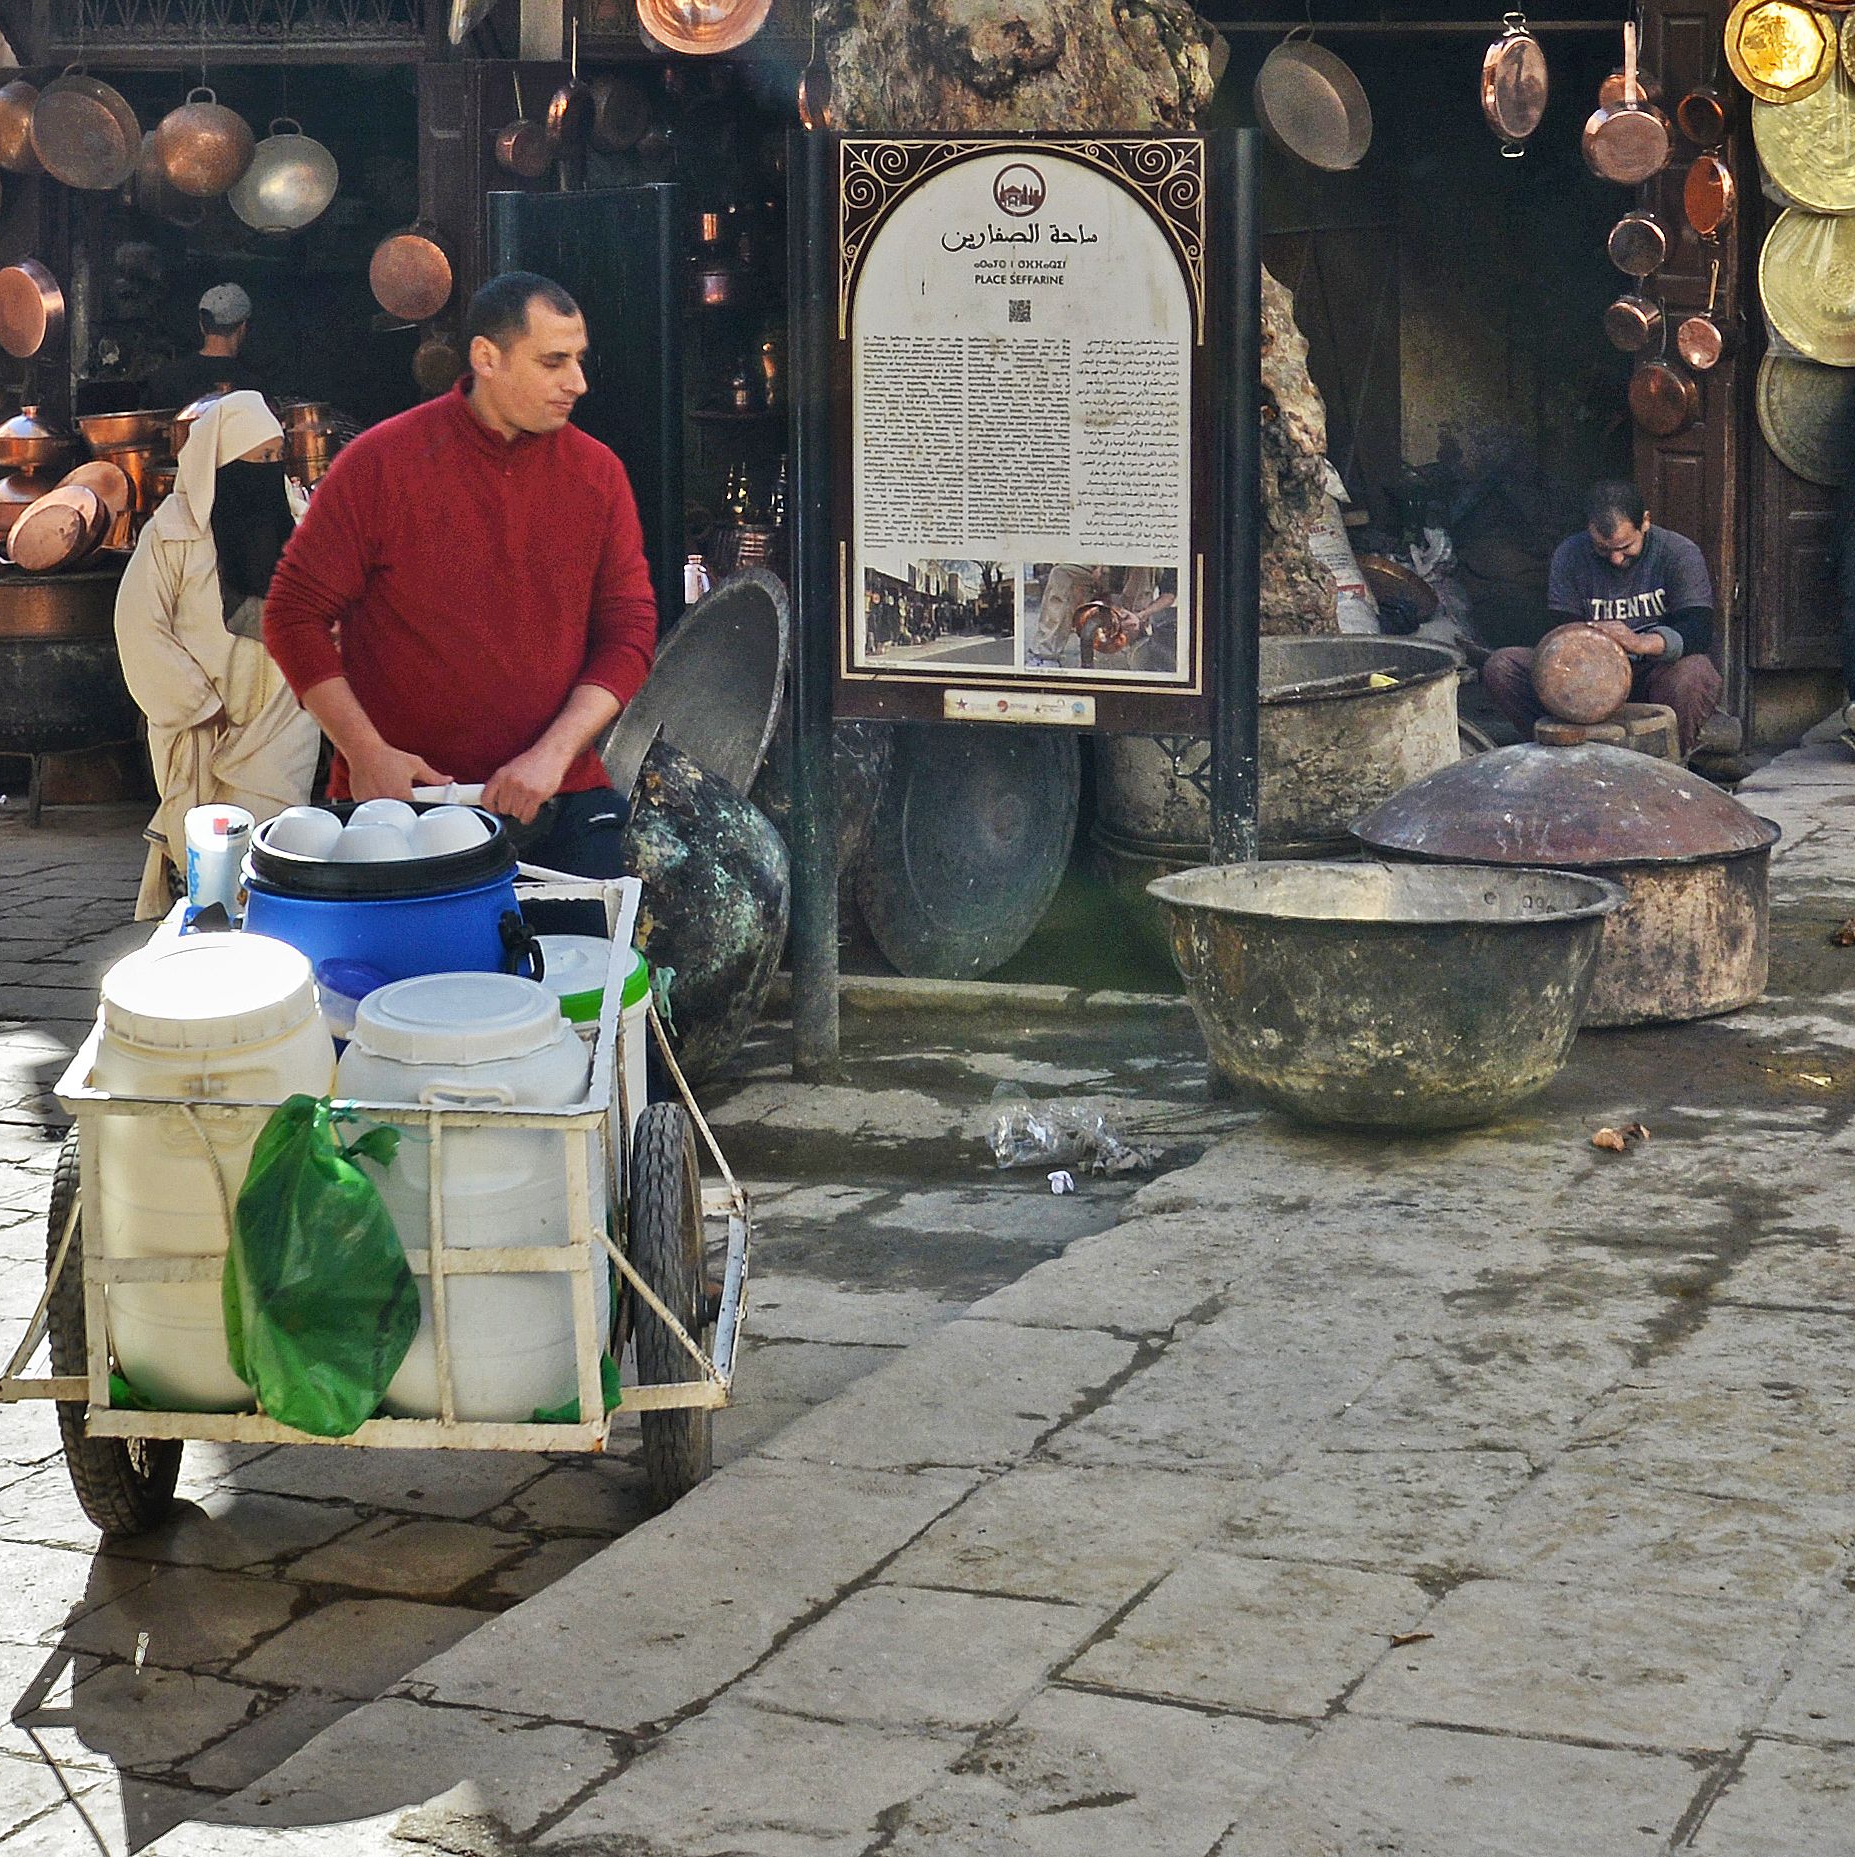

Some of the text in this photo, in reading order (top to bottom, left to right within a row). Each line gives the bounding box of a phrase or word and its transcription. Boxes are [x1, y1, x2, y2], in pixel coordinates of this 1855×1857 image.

[941, 223, 1098, 252] ساحة الصفارين
[975, 275, 1064, 285] PLACE SEFFARINE
[1587, 587, 1667, 621] THENTIC
